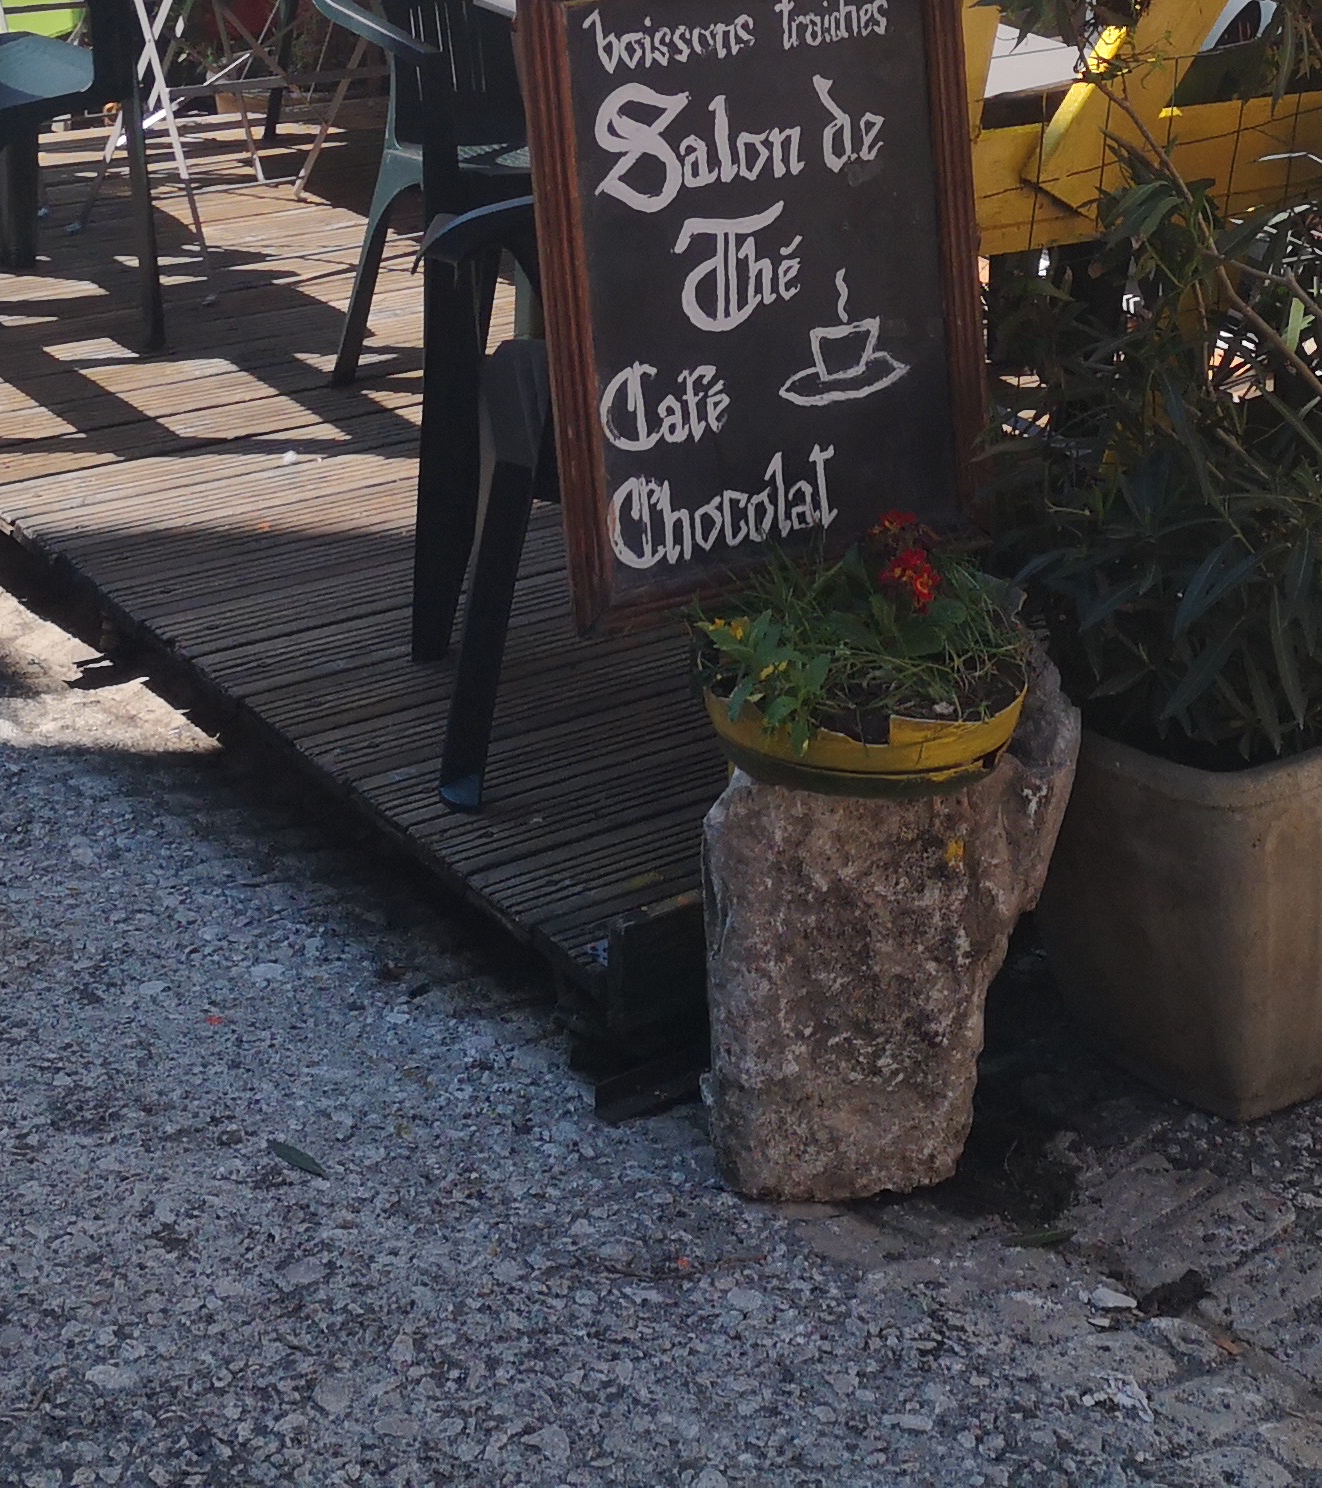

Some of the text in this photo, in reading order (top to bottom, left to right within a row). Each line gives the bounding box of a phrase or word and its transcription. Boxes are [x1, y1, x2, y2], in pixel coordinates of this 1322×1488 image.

[582, 9, 755, 74] boissons
[594, 74, 885, 214] Salon de
[671, 200, 803, 332] Thé
[599, 360, 731, 451] Café
[606, 444, 839, 569] Chocolat
